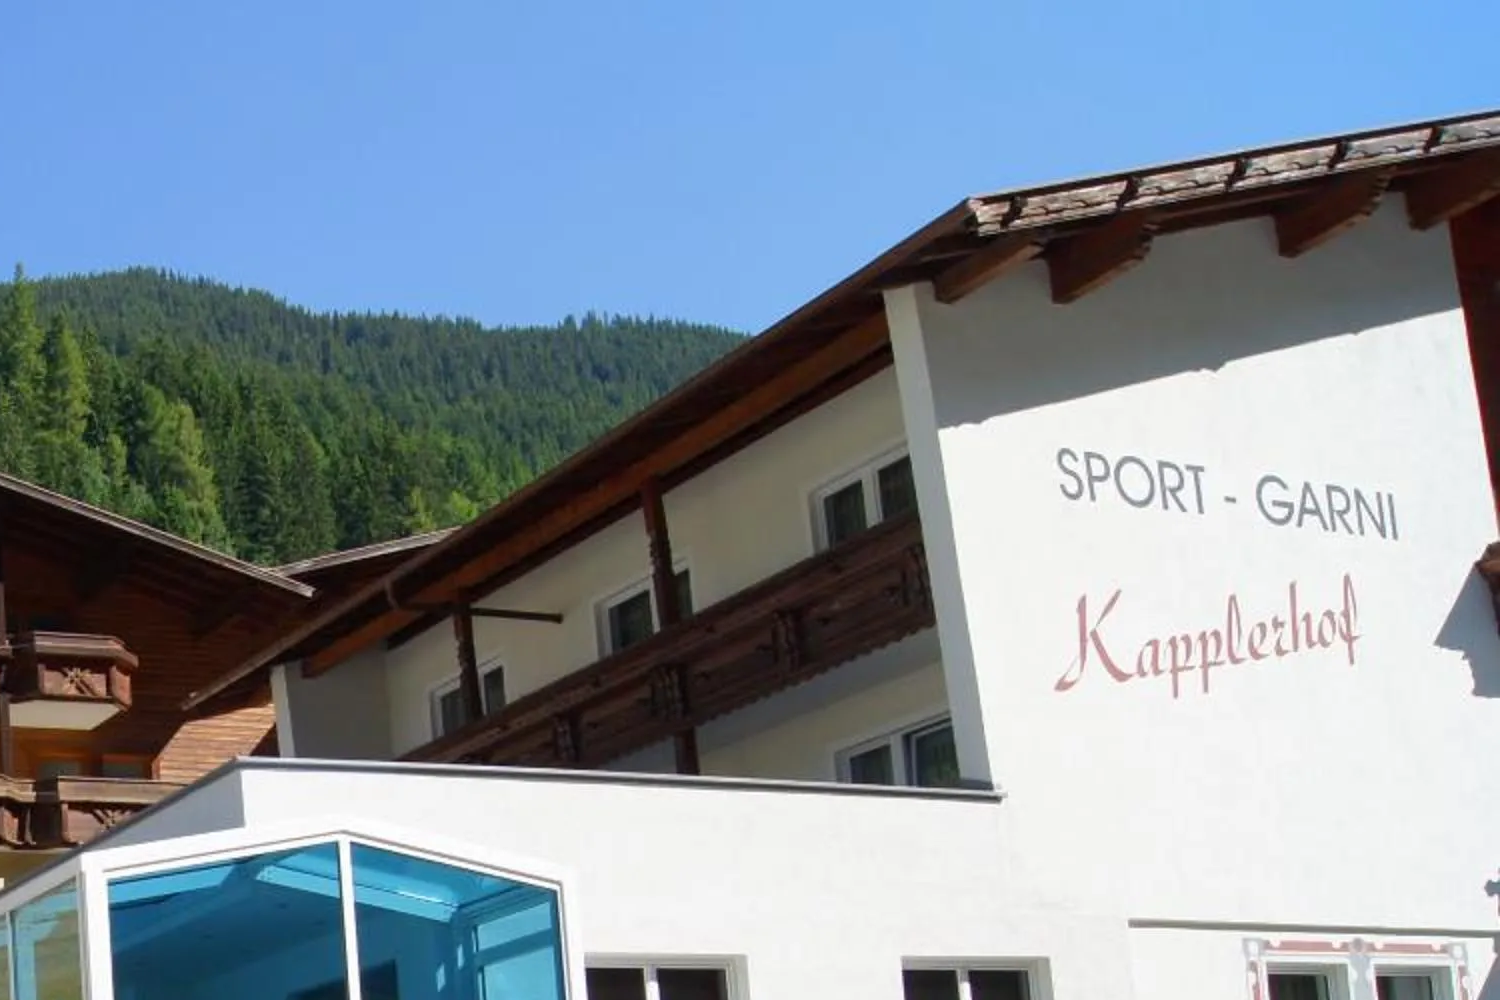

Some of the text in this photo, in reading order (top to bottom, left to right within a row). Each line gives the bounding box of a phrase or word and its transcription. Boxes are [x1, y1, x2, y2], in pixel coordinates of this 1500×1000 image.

[1057, 448, 1205, 515] SPORT
[1255, 475, 1400, 540] GARNI
[1054, 573, 1361, 699] Kapplerhof
